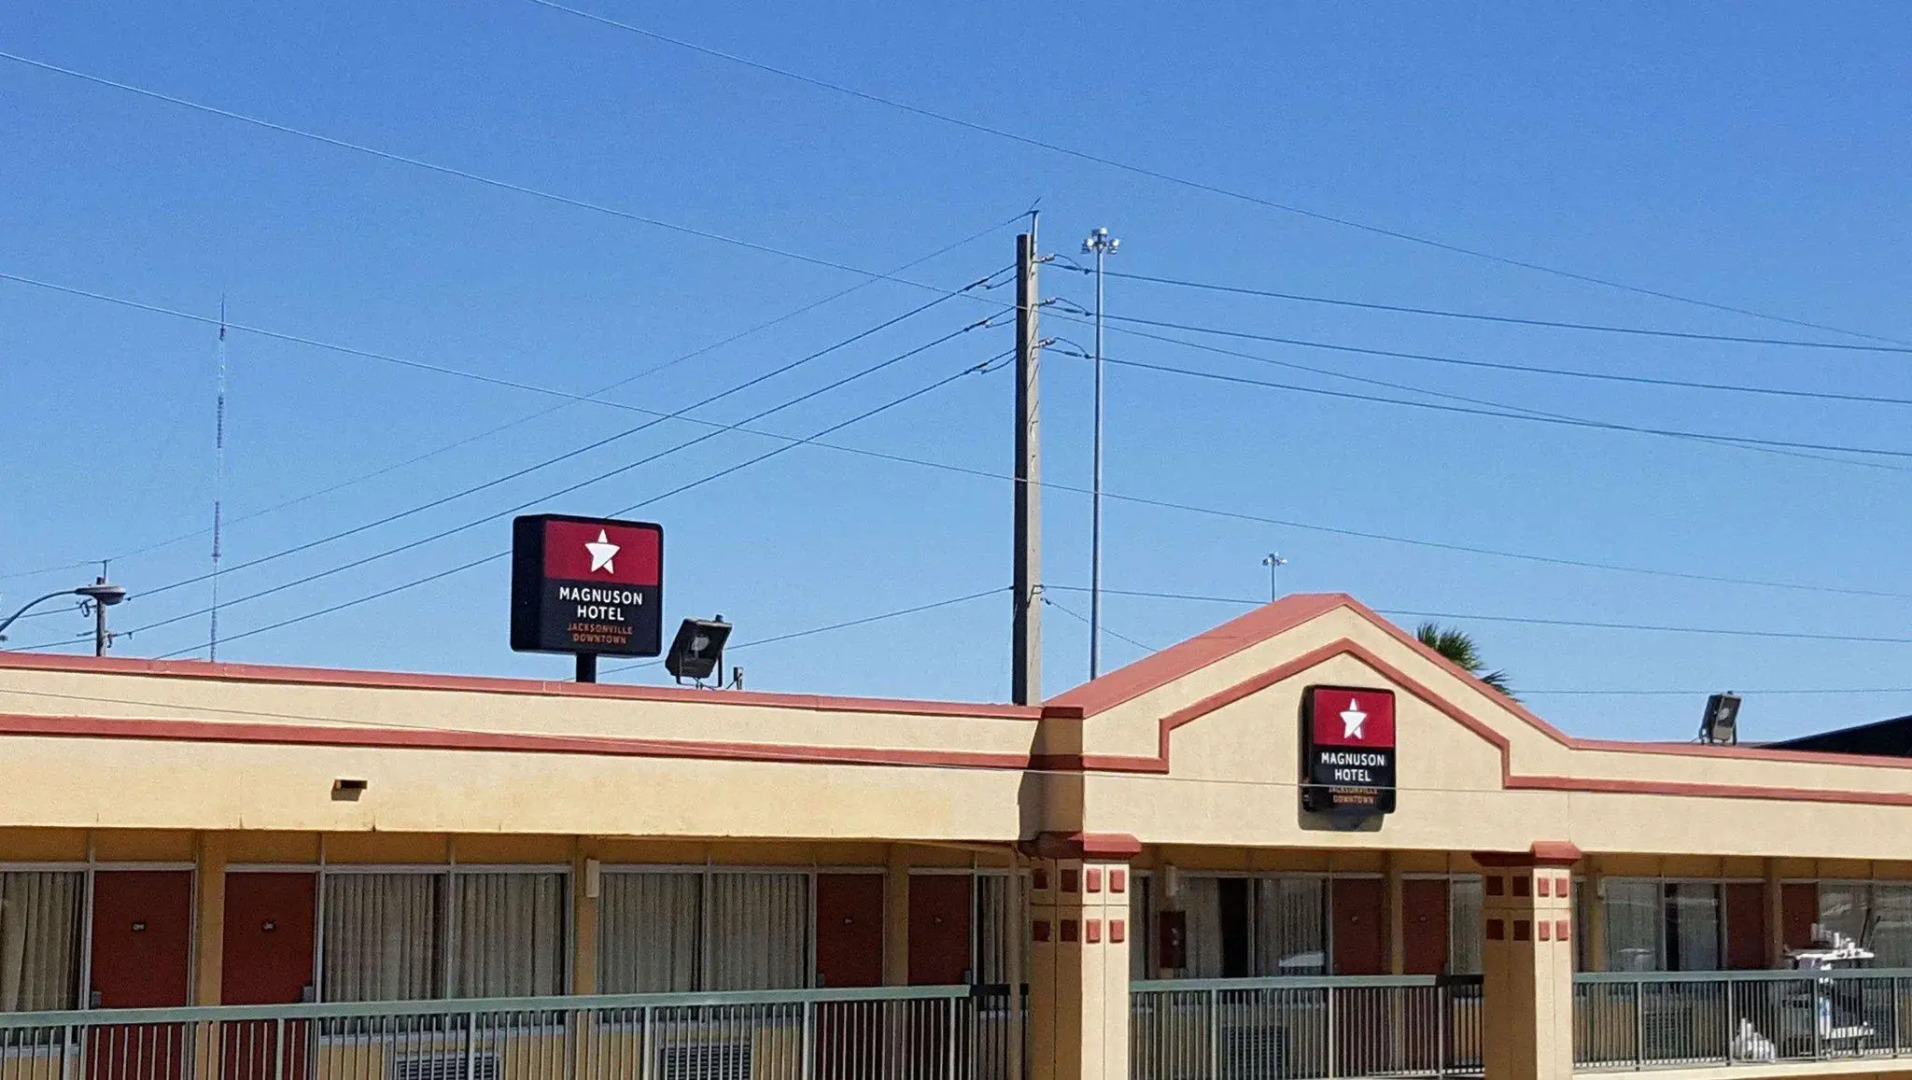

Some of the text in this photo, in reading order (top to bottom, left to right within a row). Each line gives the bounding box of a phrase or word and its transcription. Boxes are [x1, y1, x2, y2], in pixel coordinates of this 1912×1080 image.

[559, 587, 643, 605] MAGNUSON
[577, 605, 625, 621] HOTEL
[567, 623, 633, 635] JACKSONVILLE
[573, 633, 627, 644] DOWNTOWN
[1321, 752, 1385, 766] MAGNUSON
[1334, 768, 1372, 782] HOTEL
